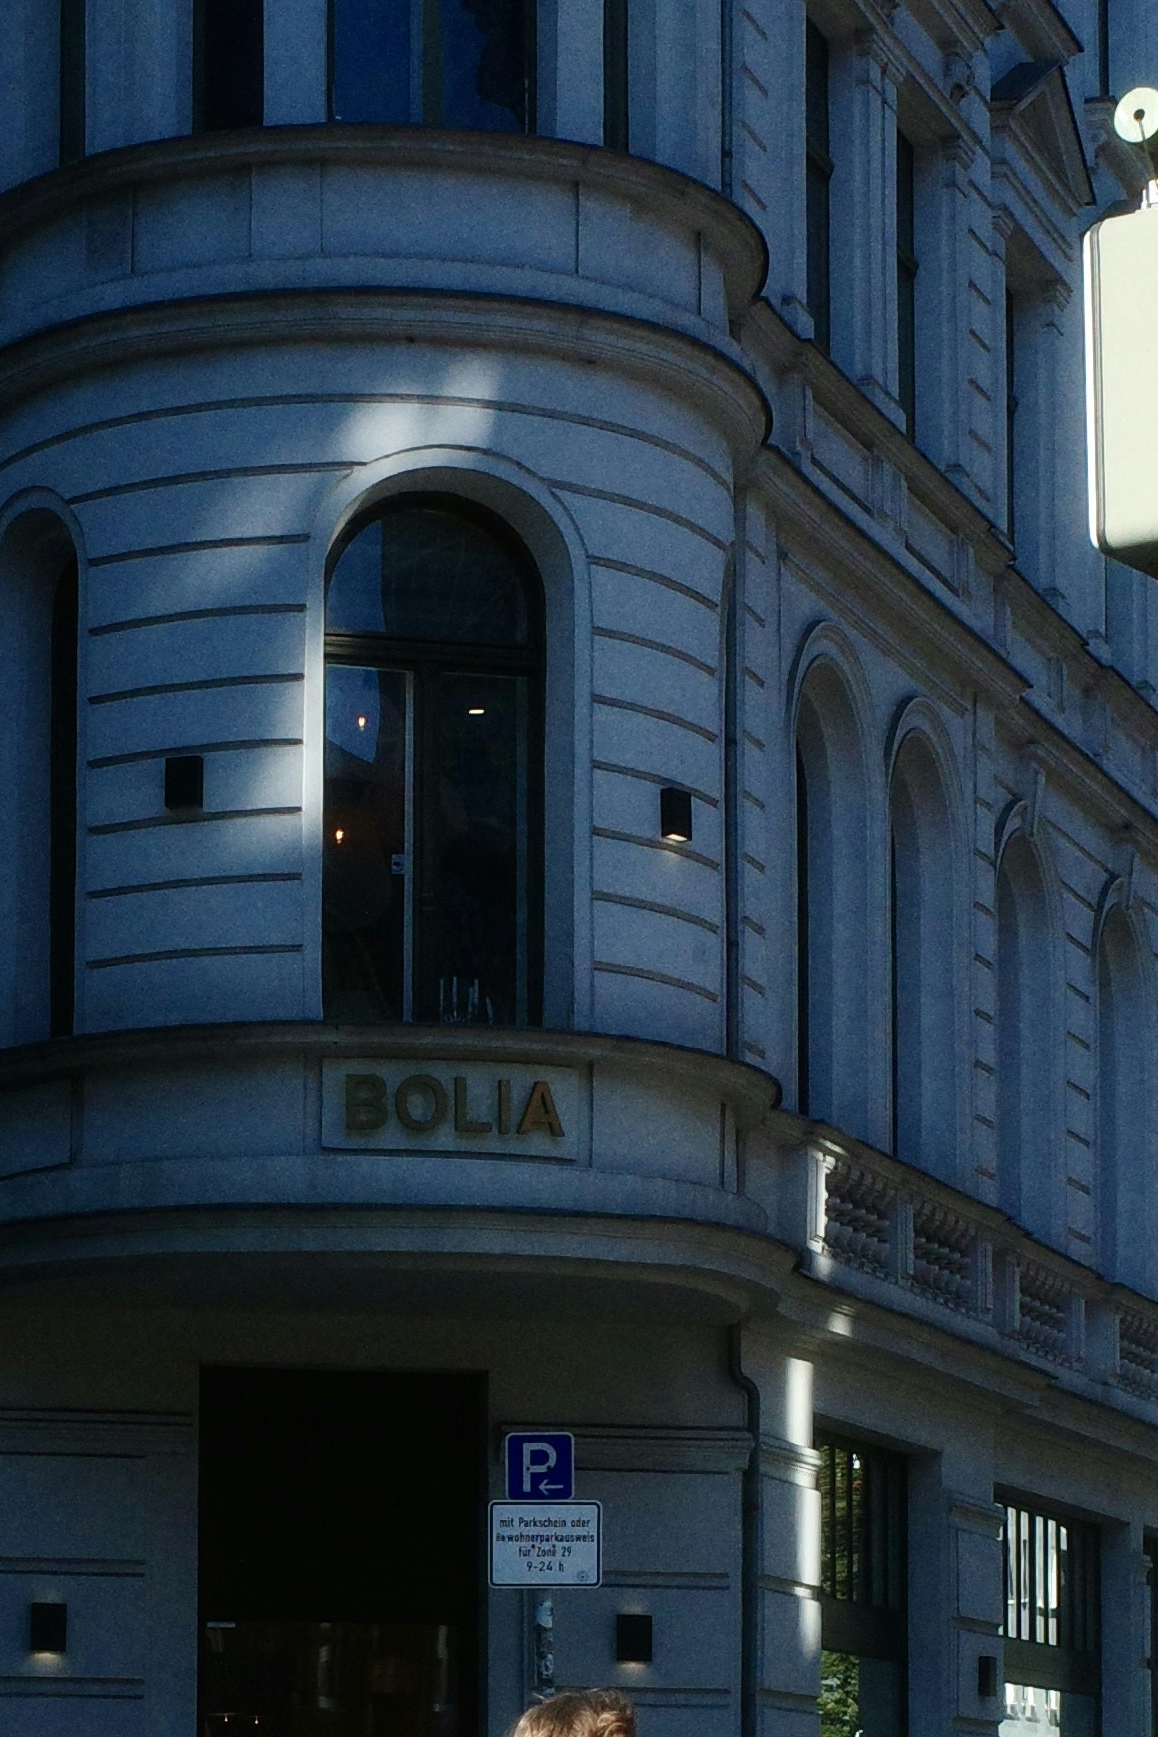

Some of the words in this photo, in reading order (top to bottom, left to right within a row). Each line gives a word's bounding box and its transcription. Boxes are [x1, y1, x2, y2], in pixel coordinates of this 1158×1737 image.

[345, 1073, 564, 1137] BOLIA
[522, 1442, 557, 1493] P
[499, 1517, 514, 1528] mit
[518, 1516, 567, 1528] Parkschein
[570, 1517, 591, 1528] oder
[496, 1531, 595, 1544] Bewohnerparkausweis
[518, 1545, 531, 1558] für
[536, 1546, 557, 1558] Zone
[561, 1546, 572, 1557] 29
[526, 1560, 553, 1572] 9-24
[558, 1560, 565, 1572] h
